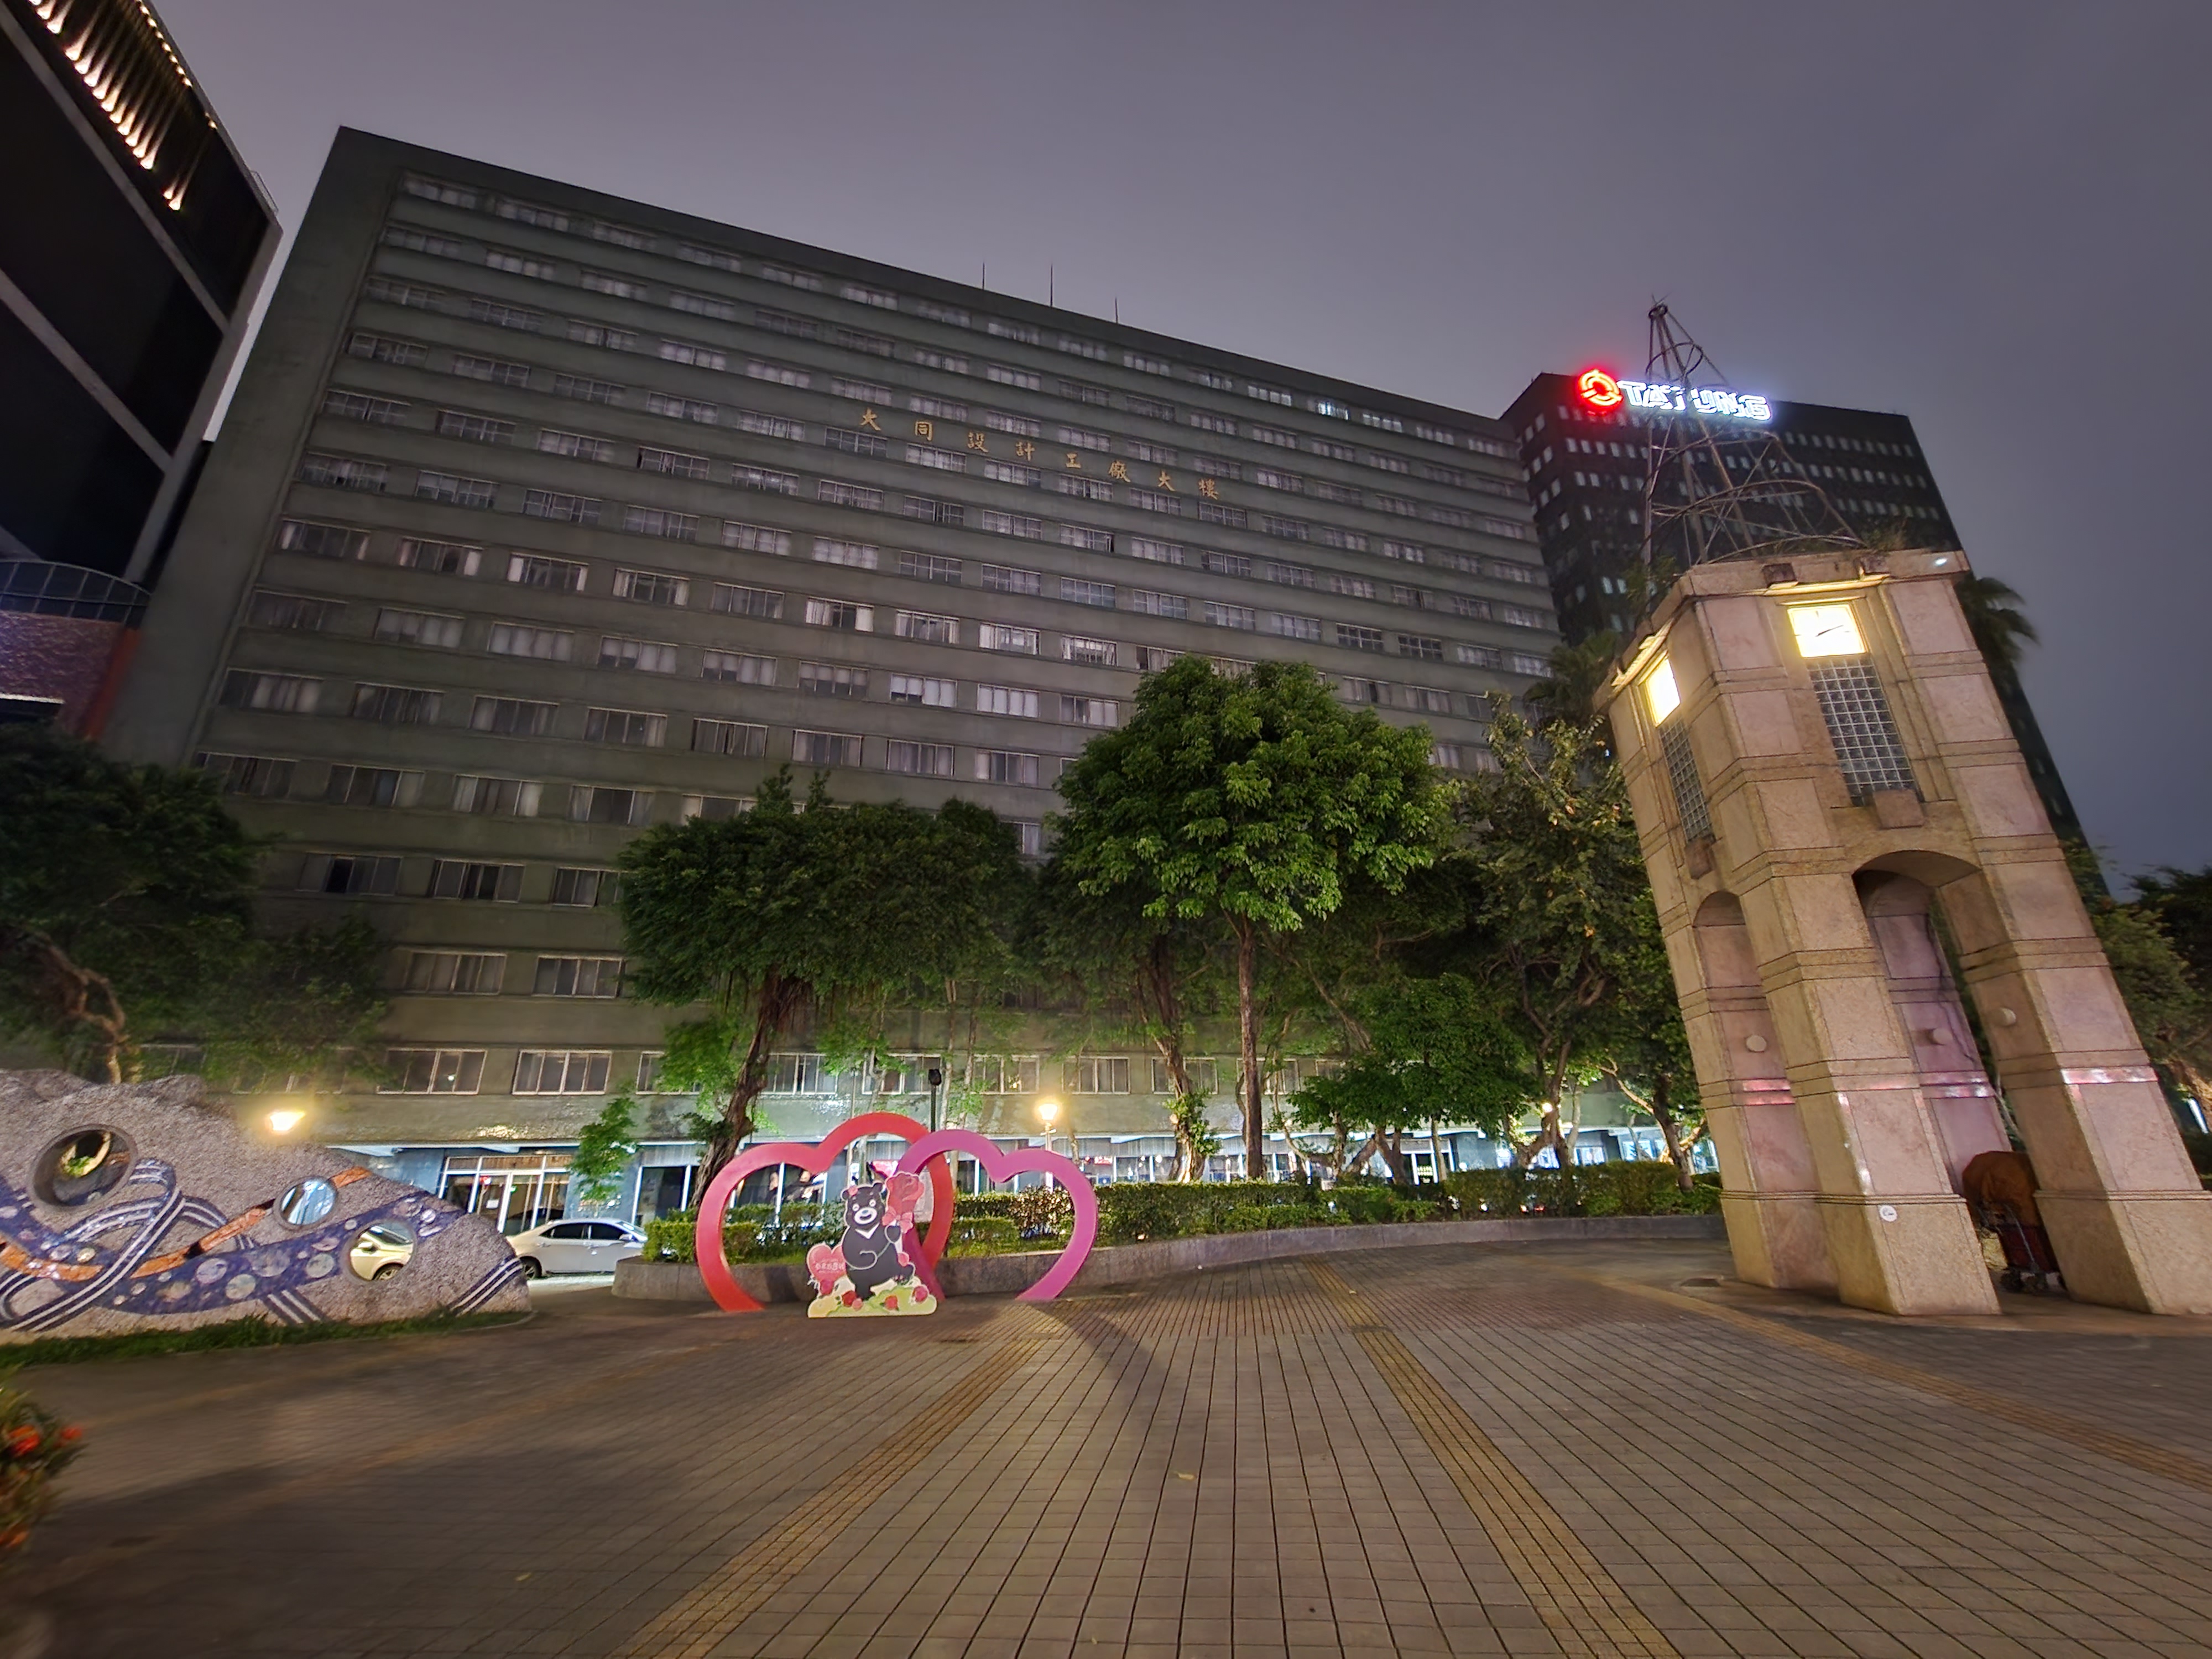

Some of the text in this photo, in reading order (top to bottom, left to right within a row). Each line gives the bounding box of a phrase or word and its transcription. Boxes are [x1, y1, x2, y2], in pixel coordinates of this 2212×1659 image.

[860, 408, 1219, 500] 大同設計工廠大樓
